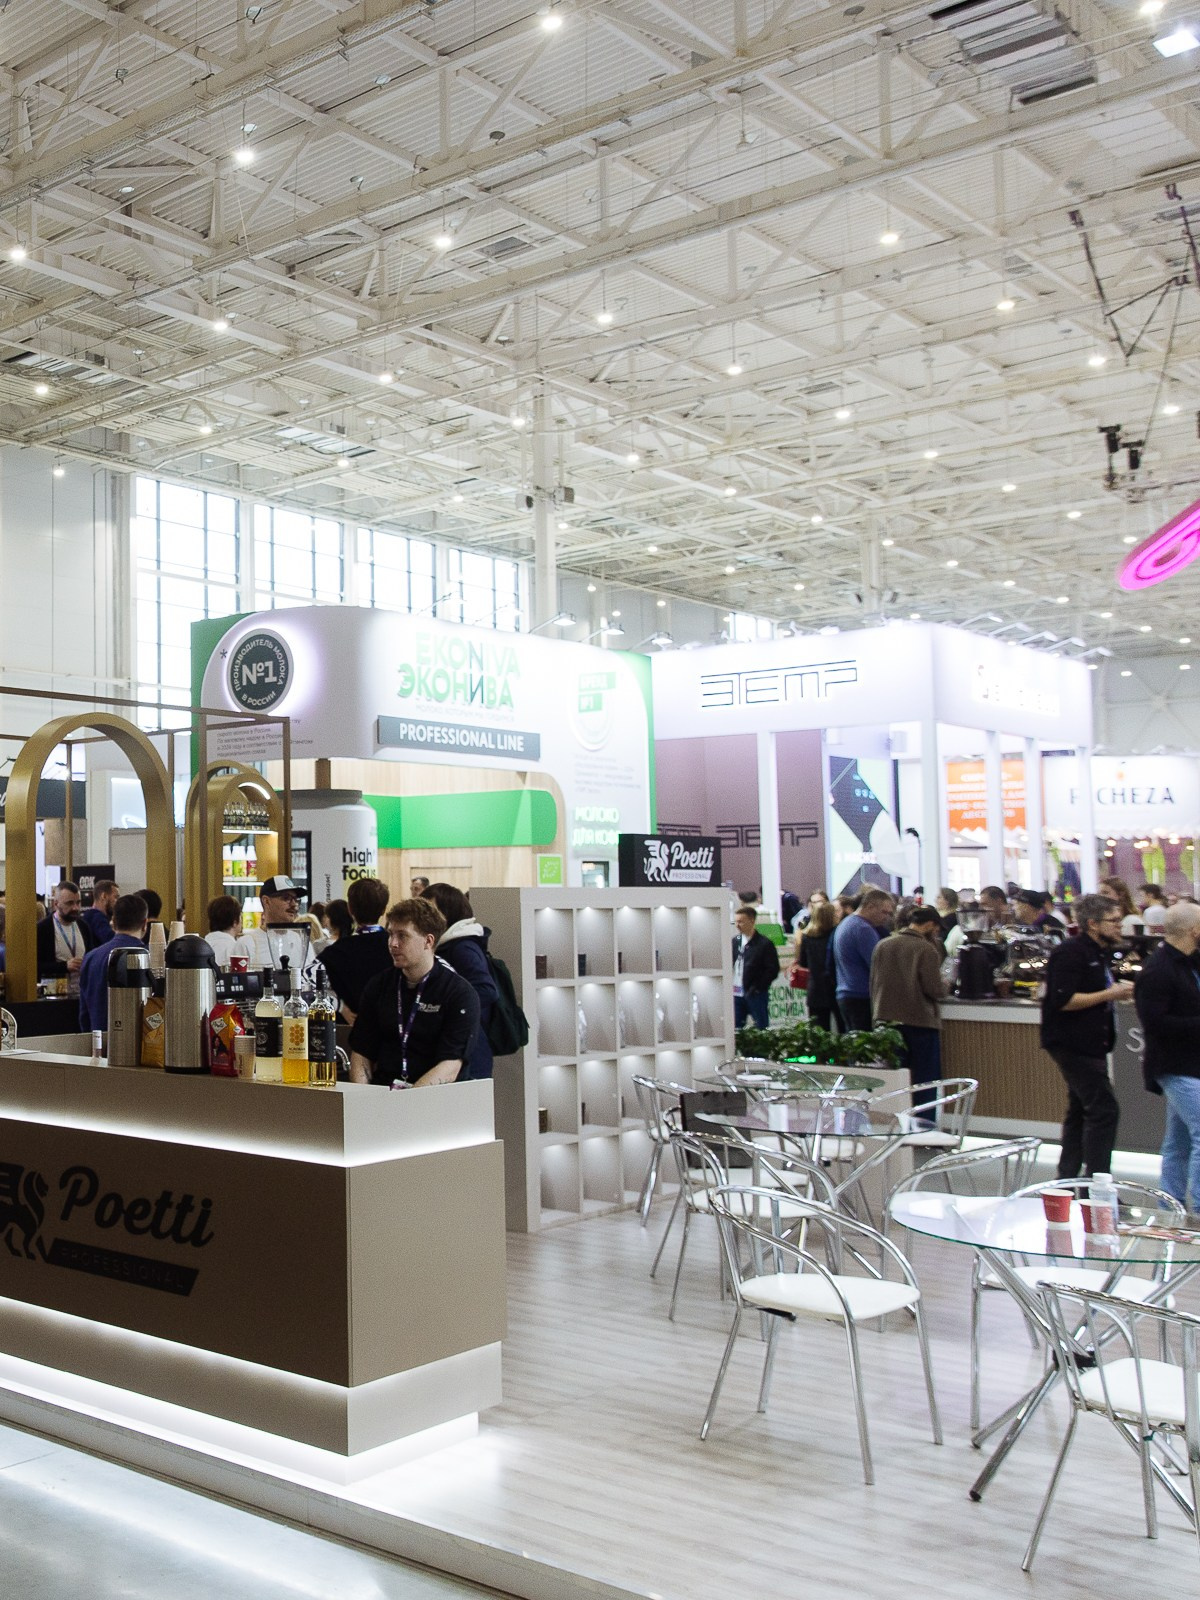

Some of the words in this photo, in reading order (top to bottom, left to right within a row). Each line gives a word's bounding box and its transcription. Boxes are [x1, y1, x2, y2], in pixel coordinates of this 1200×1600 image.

[233, 639, 274, 691] ПРОИЗВОДИТЕЛЬ
[273, 645, 286, 685] МОЛОКА
[416, 632, 520, 678] EKONIVA
[242, 661, 278, 686] №1
[397, 663, 514, 709] ЭКОНИВА
[241, 693, 248, 701] В
[247, 691, 276, 706] РОССИИ
[400, 722, 496, 749] PROFESSIONAL
[497, 734, 525, 752] LINE
[1070, 788, 1175, 805] FCHEZA
[575, 806, 619, 822] МОЛОКО
[342, 847, 373, 867] high
[671, 841, 715, 868] Poetti
[59, 1165, 215, 1248] Poetti
[61, 1247, 185, 1290] PROFESSIONAL
